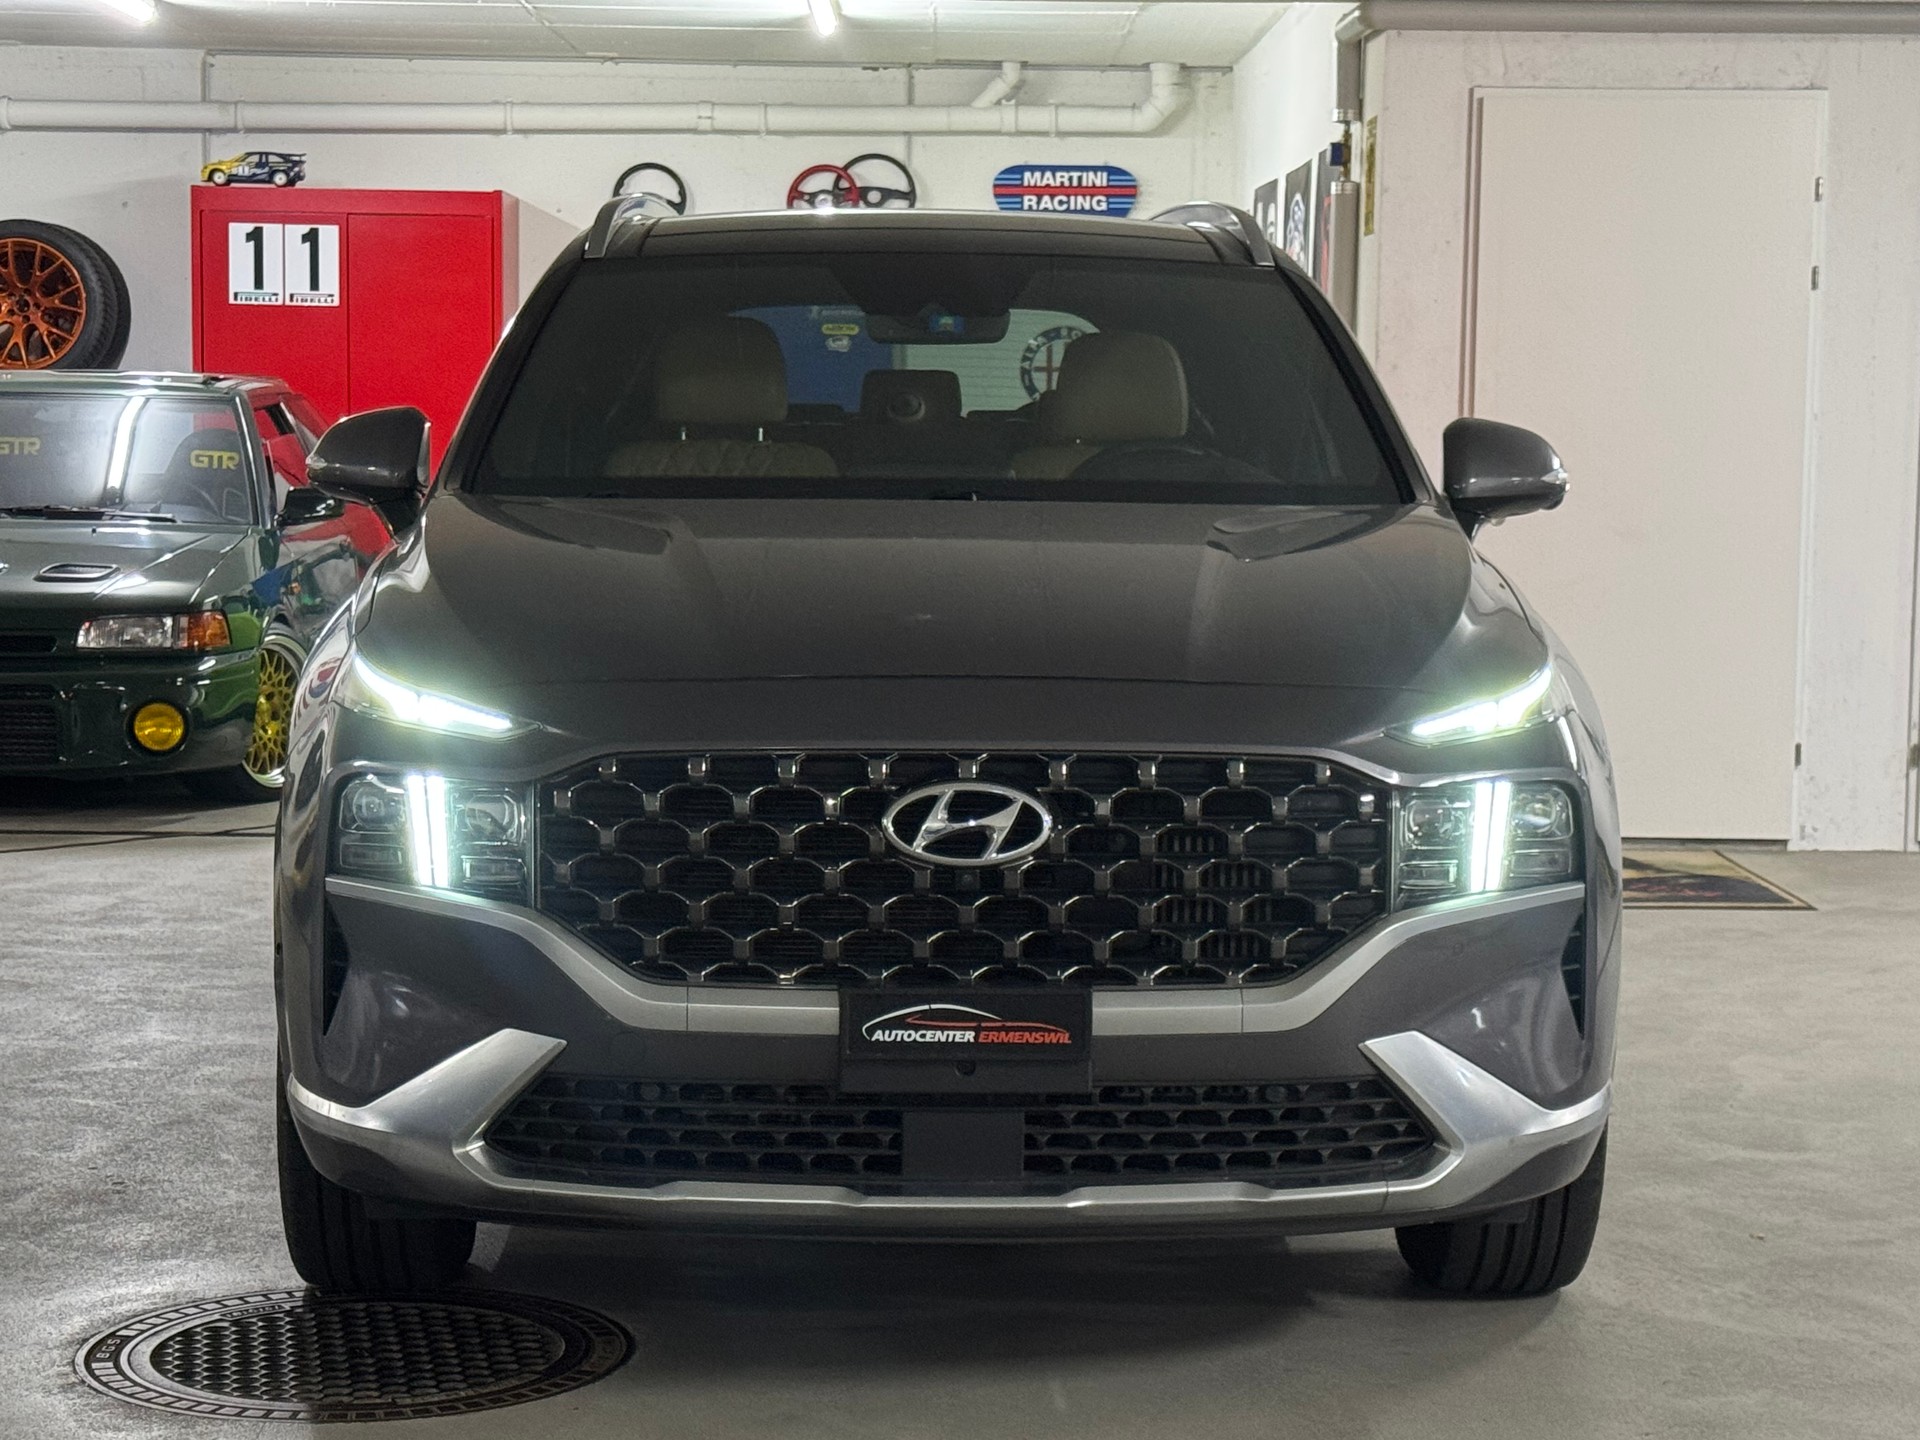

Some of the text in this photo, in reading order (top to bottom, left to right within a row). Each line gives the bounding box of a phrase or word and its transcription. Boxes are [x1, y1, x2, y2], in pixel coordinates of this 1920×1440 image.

[1023, 171, 1108, 187] MARTINI
[1023, 195, 1108, 211] RACING
[189, 450, 240, 470] GTR
[871, 1030, 1072, 1044] AUTOCENTER ERMENSWIL
